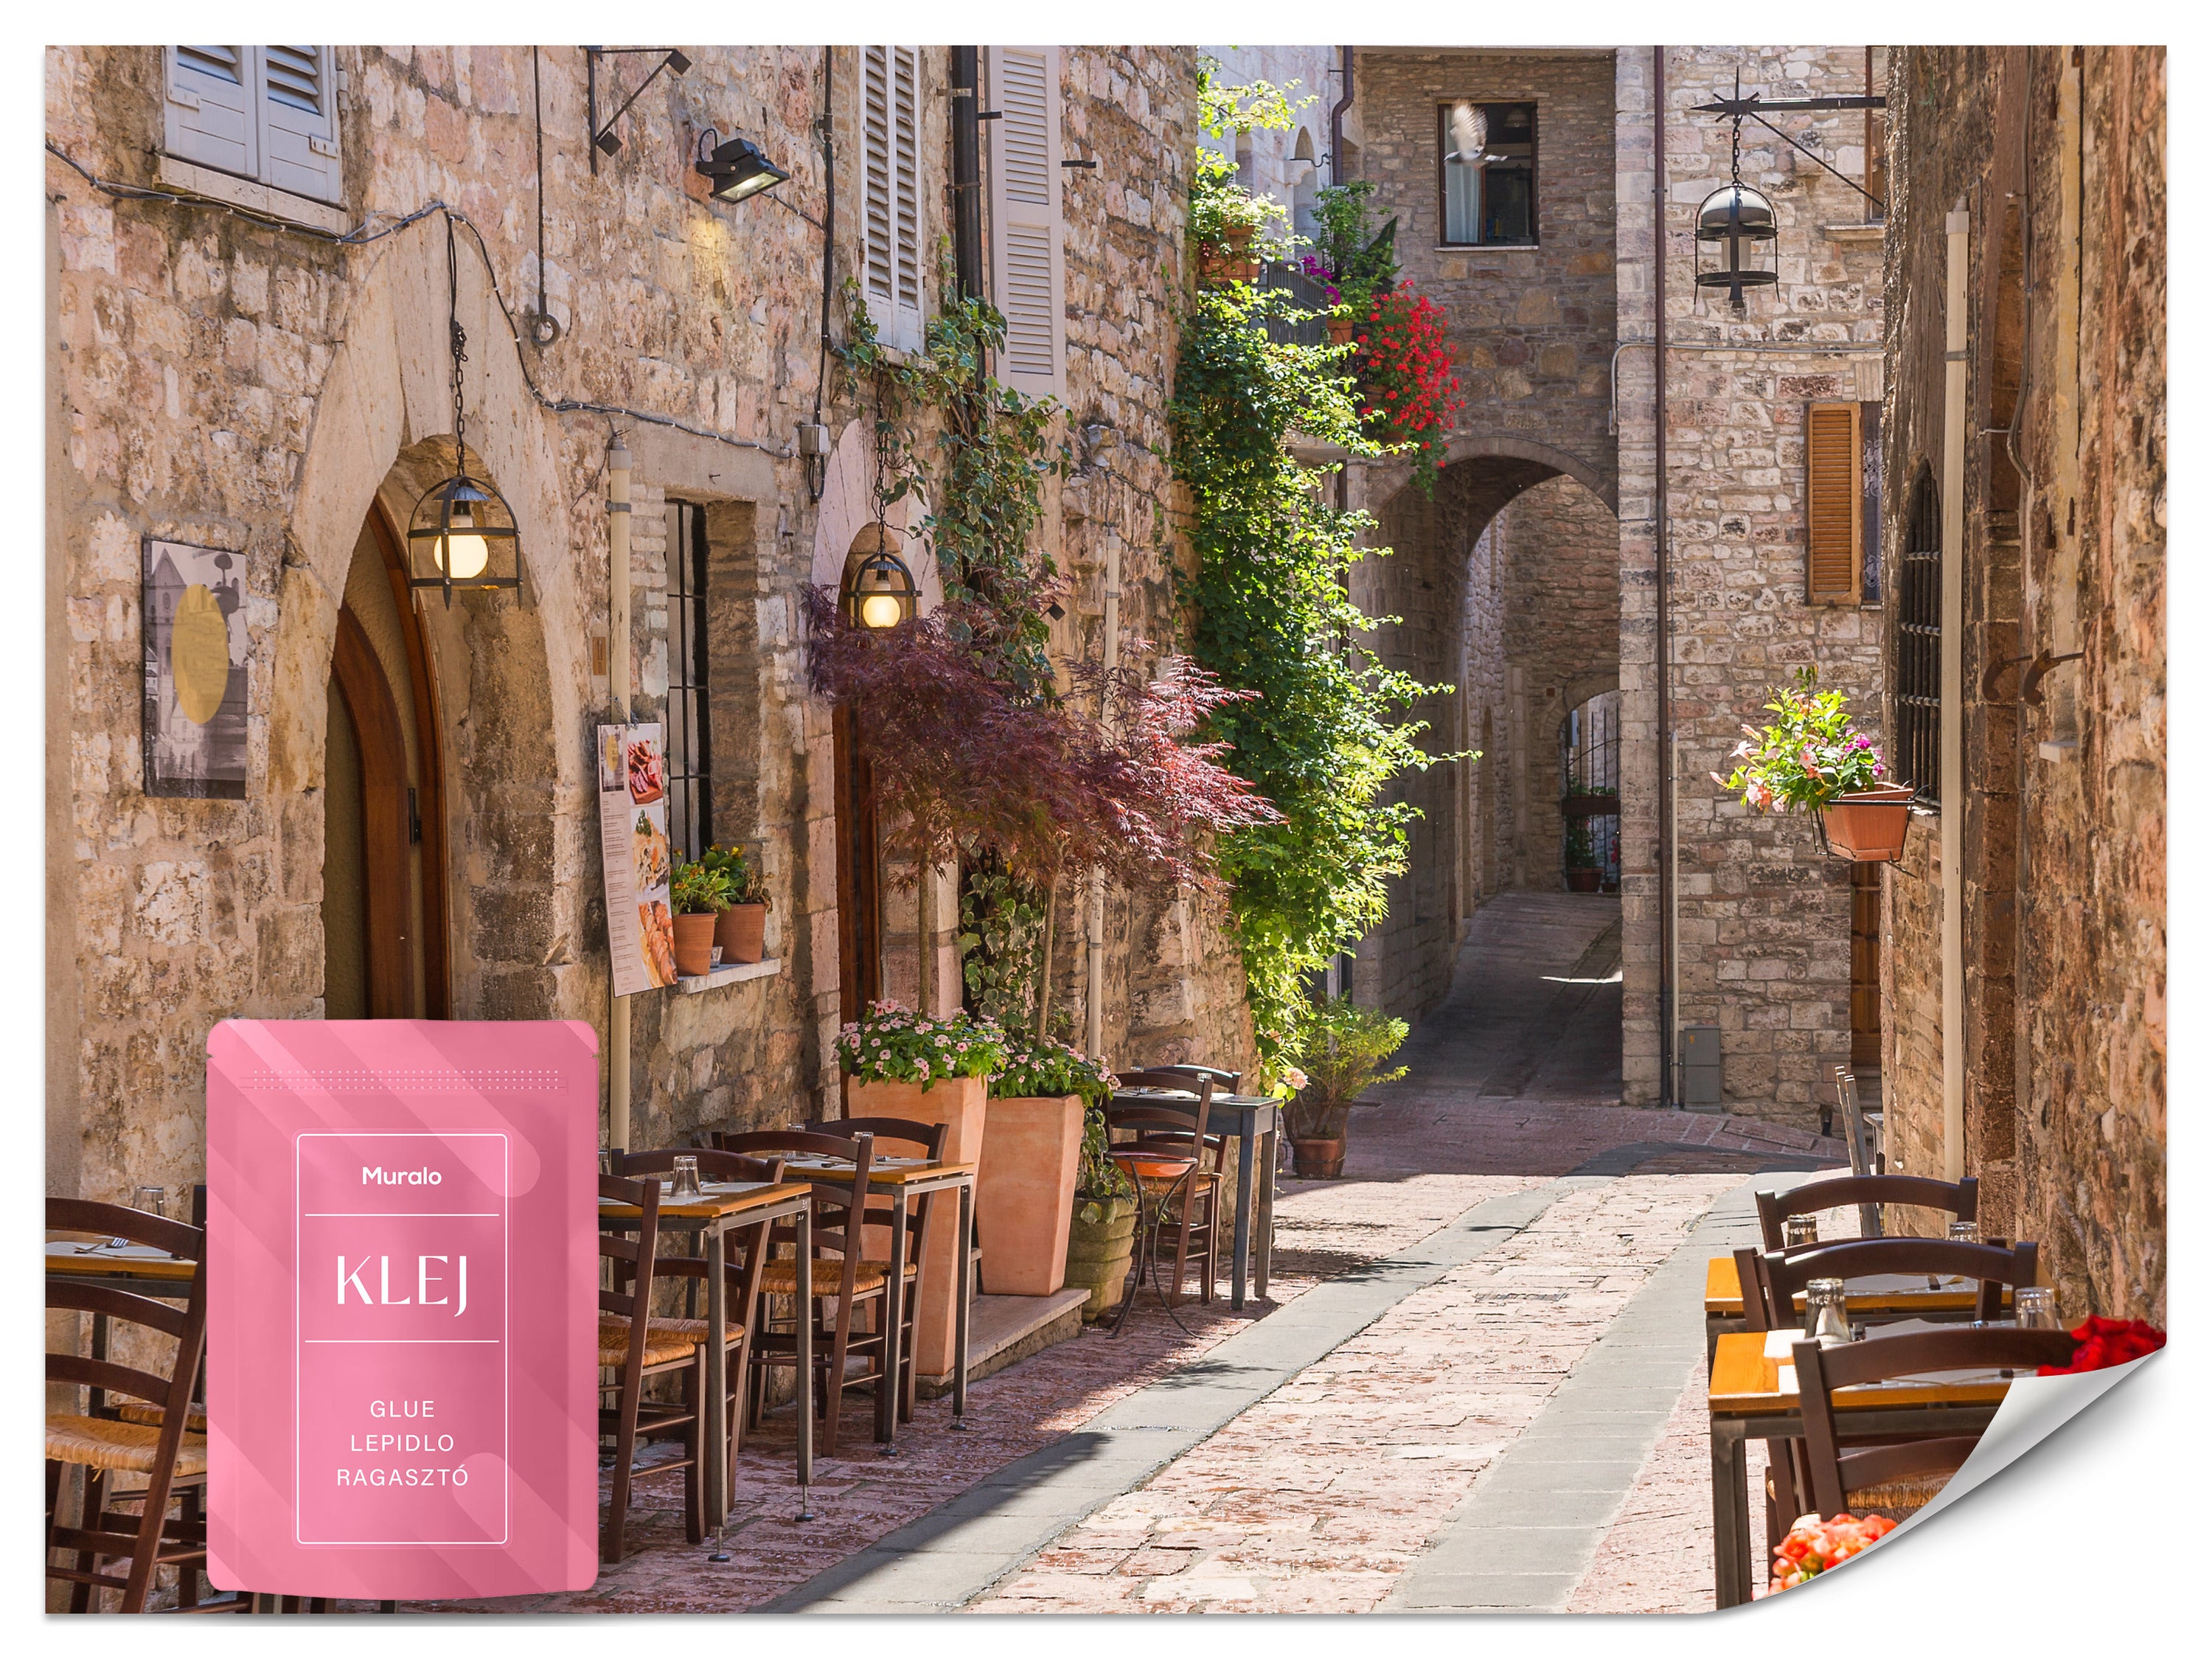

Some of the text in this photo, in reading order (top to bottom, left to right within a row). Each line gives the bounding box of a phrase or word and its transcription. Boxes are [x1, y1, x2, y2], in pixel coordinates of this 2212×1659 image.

[362, 1166, 442, 1186] Muralo
[337, 1255, 467, 1318] KLEJ
[370, 1400, 434, 1418] GLUE
[351, 1435, 454, 1452] LEPIDLO
[337, 1464, 469, 1486] RAGASZTÓ
